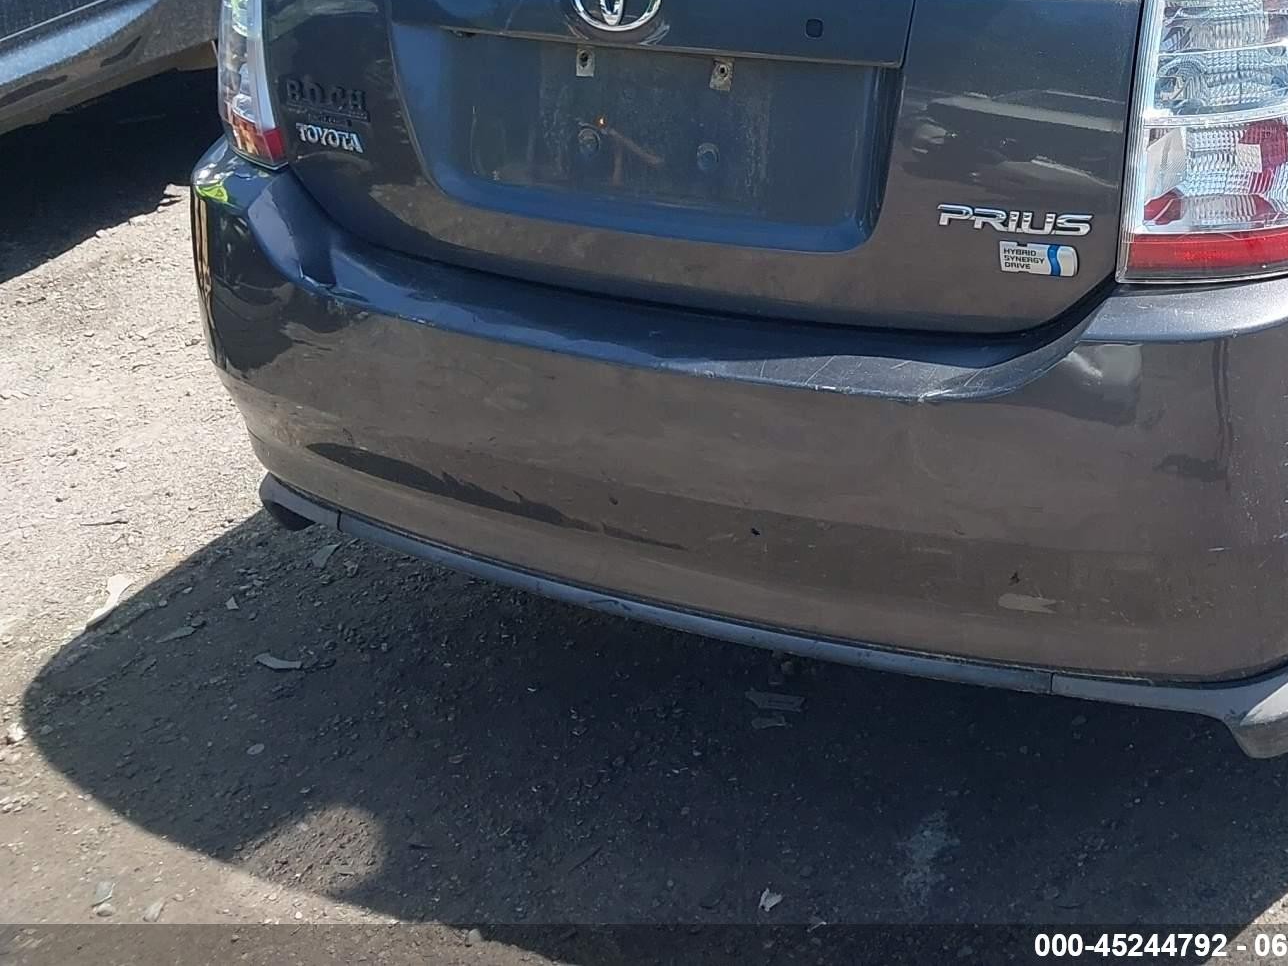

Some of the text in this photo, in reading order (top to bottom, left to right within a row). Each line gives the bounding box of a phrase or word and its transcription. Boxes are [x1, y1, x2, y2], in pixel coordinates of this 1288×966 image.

[295, 122, 364, 153] TOYOTA
[937, 204, 1093, 236] PRIUS
[1003, 248, 1037, 257] HYBRID
[1003, 254, 1045, 264] SYNERGY
[1004, 261, 1031, 270] DRIVE
